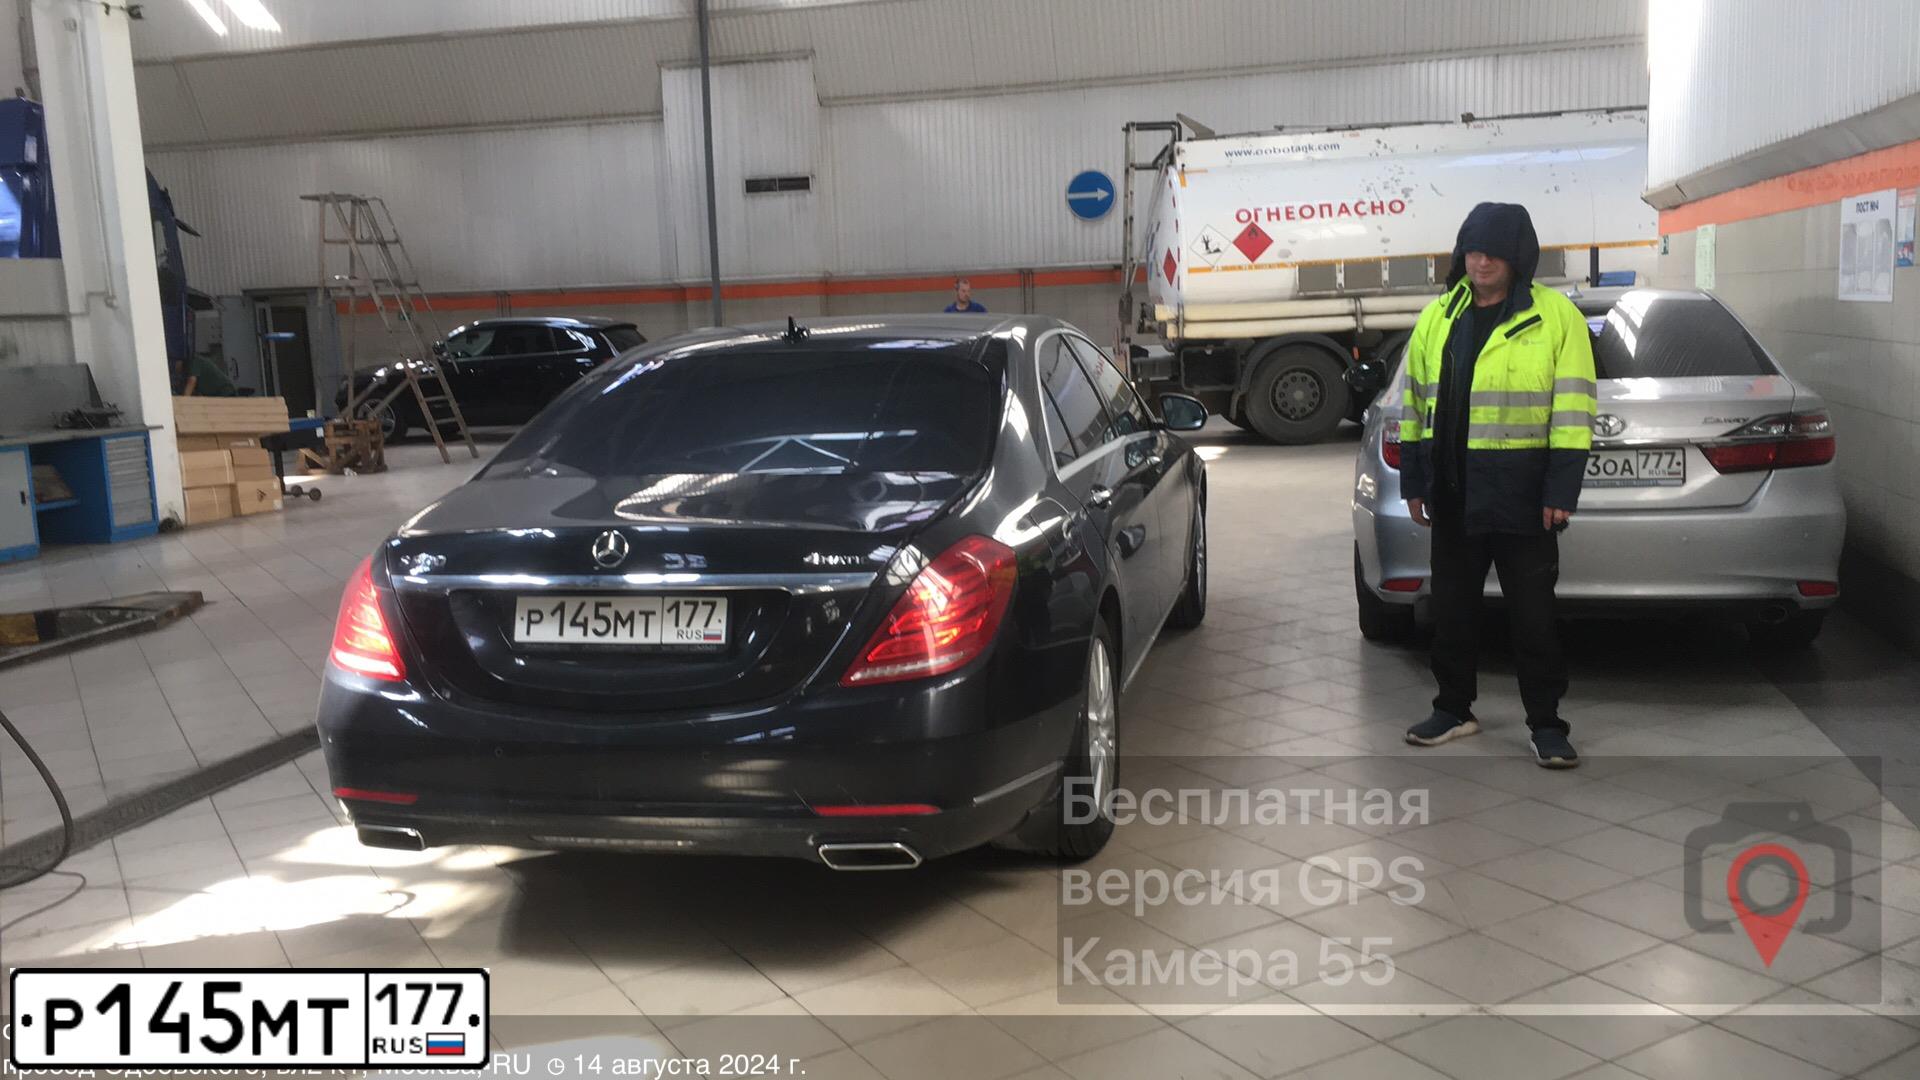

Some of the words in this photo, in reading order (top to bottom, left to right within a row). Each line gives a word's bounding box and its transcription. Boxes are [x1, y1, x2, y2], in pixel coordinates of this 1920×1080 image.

[1235, 198, 1406, 224] ОГНЕОПАСНО
[1638, 451, 1677, 469] 777
[666, 600, 717, 628] 177
[676, 630, 703, 640] RUS
